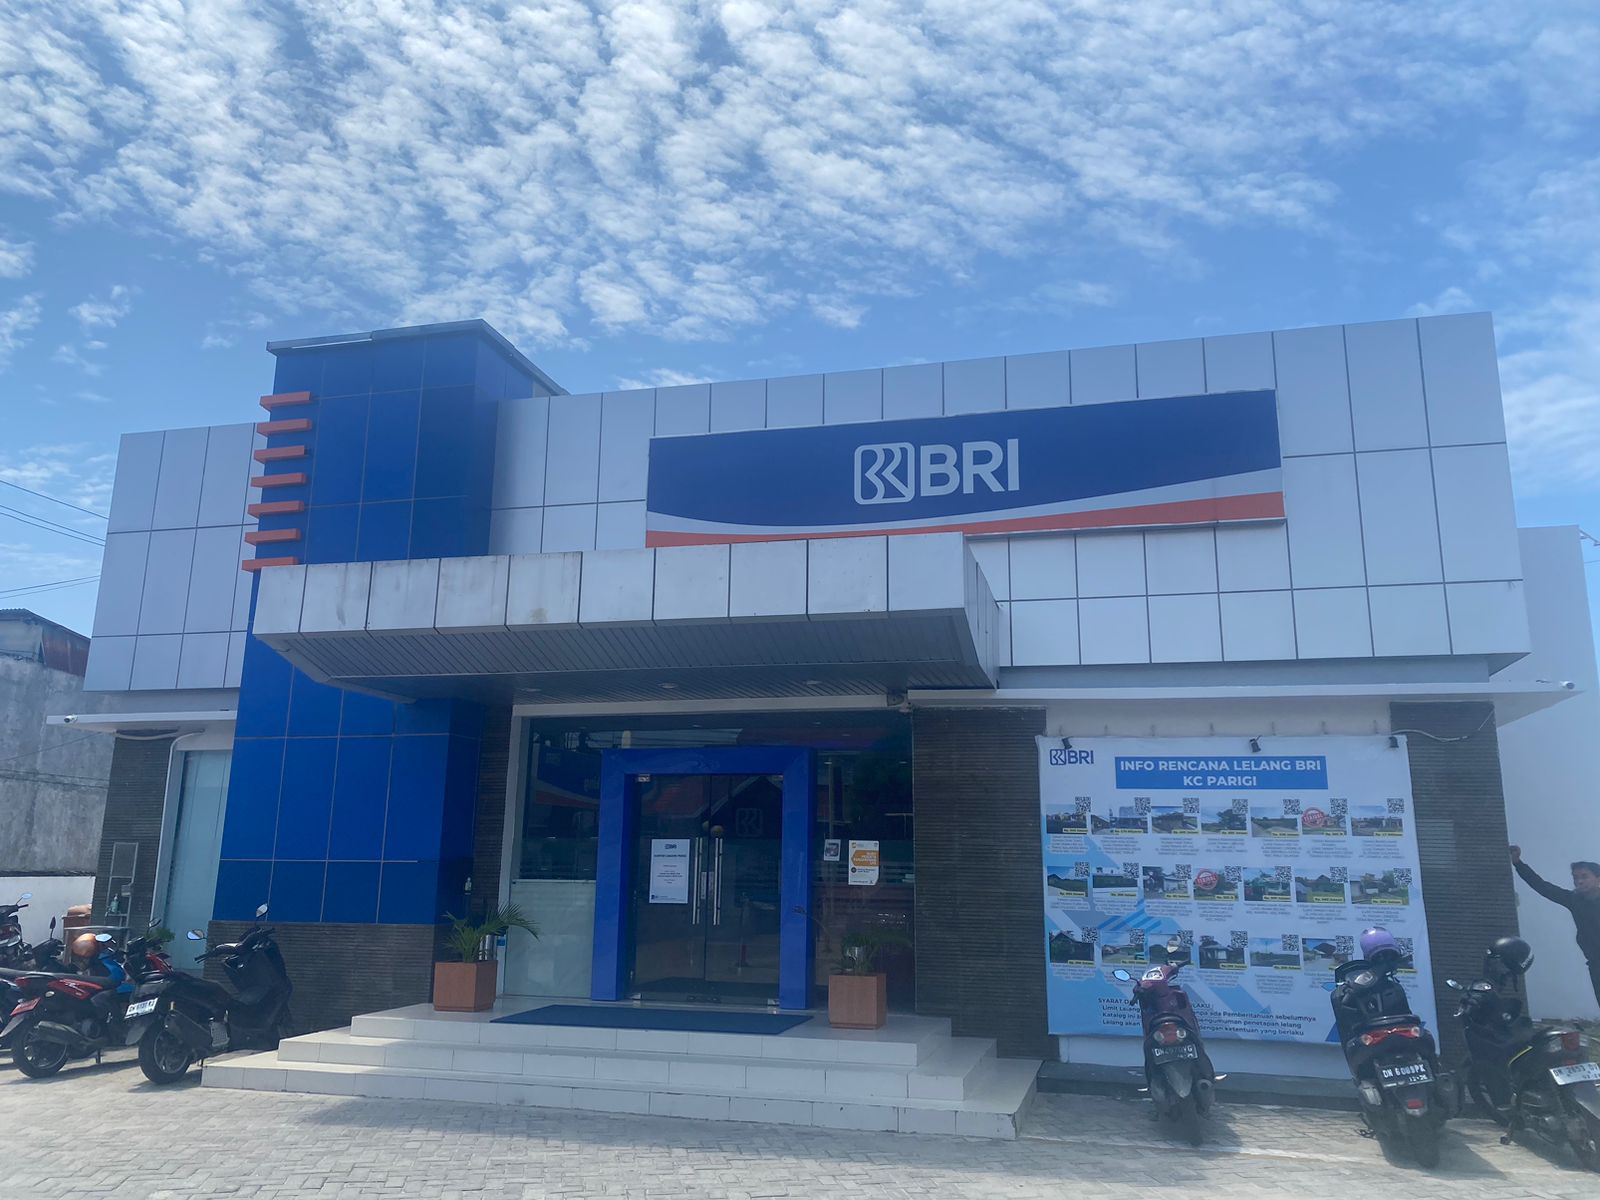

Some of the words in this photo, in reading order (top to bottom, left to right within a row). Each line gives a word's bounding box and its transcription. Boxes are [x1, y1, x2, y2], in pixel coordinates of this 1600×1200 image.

[919, 438, 1021, 498] BRI
[1067, 750, 1094, 765] BRI
[1120, 760, 1155, 772] INFO
[1158, 760, 1230, 772] RENCANA
[1233, 760, 1292, 772] LELANG
[1295, 760, 1321, 771] BRI
[1183, 776, 1203, 787] KC
[1206, 775, 1257, 787] PARIGI
[1222, 1011, 1274, 1020] Pemberitahuan
[1275, 1014, 1316, 1023] sebelumnya
[1280, 1021, 1302, 1029] lelang
